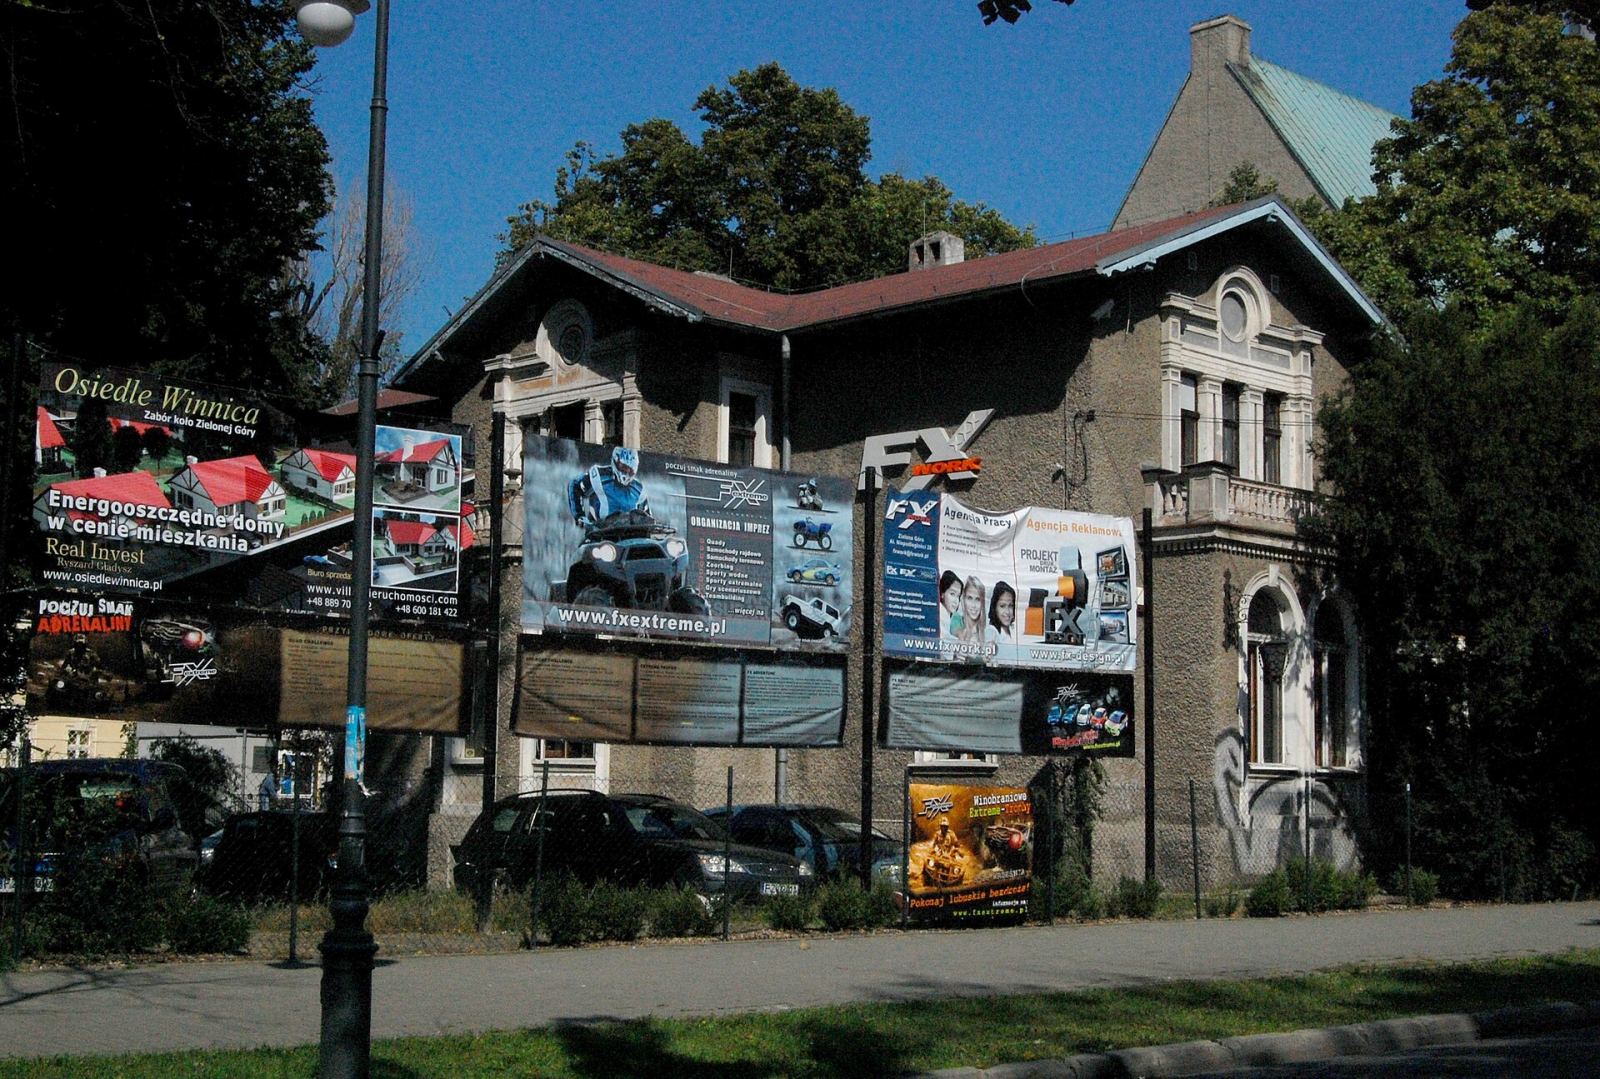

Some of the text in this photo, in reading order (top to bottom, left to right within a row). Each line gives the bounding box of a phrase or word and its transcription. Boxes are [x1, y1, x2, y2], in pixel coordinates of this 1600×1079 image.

[55, 368, 260, 425] Osiedle Winnica
[144, 410, 171, 423] Zabór
[196, 418, 233, 435] Zielonej
[234, 423, 257, 438] Góry
[912, 456, 983, 476] WORK
[48, 489, 285, 540] Energooszczędne domy
[885, 498, 938, 530] FX
[944, 506, 1012, 529] Agencja Pracy
[47, 516, 249, 553] w cenie mieszkania
[690, 515, 770, 535] ORGANIZACJA IMPREZ
[1027, 518, 1069, 534] Agencja
[46, 536, 146, 565] Real Invest
[706, 546, 738, 557] Samochody
[706, 554, 738, 564] Samochody
[1020, 548, 1058, 563] PROJEKT
[56, 557, 95, 570] Ryszard
[307, 568, 325, 578] Biuro
[42, 568, 164, 593] www.osiedlewinnica.pl
[706, 569, 726, 578] Sporty
[706, 576, 726, 586] Sporty
[705, 584, 716, 593] Gry
[38, 598, 134, 618] POCZUJ SMAK
[307, 596, 323, 608] +48
[324, 597, 339, 608] 889
[395, 604, 458, 618] +48 600 181 422
[36, 614, 134, 634] ADRENALINY
[558, 608, 727, 637] www.fxextreme.pl
[903, 637, 998, 656] www.fxwork.pl
[1029, 648, 1126, 666] www.fx-design.pl
[973, 792, 1027, 806] Winobraniowe
